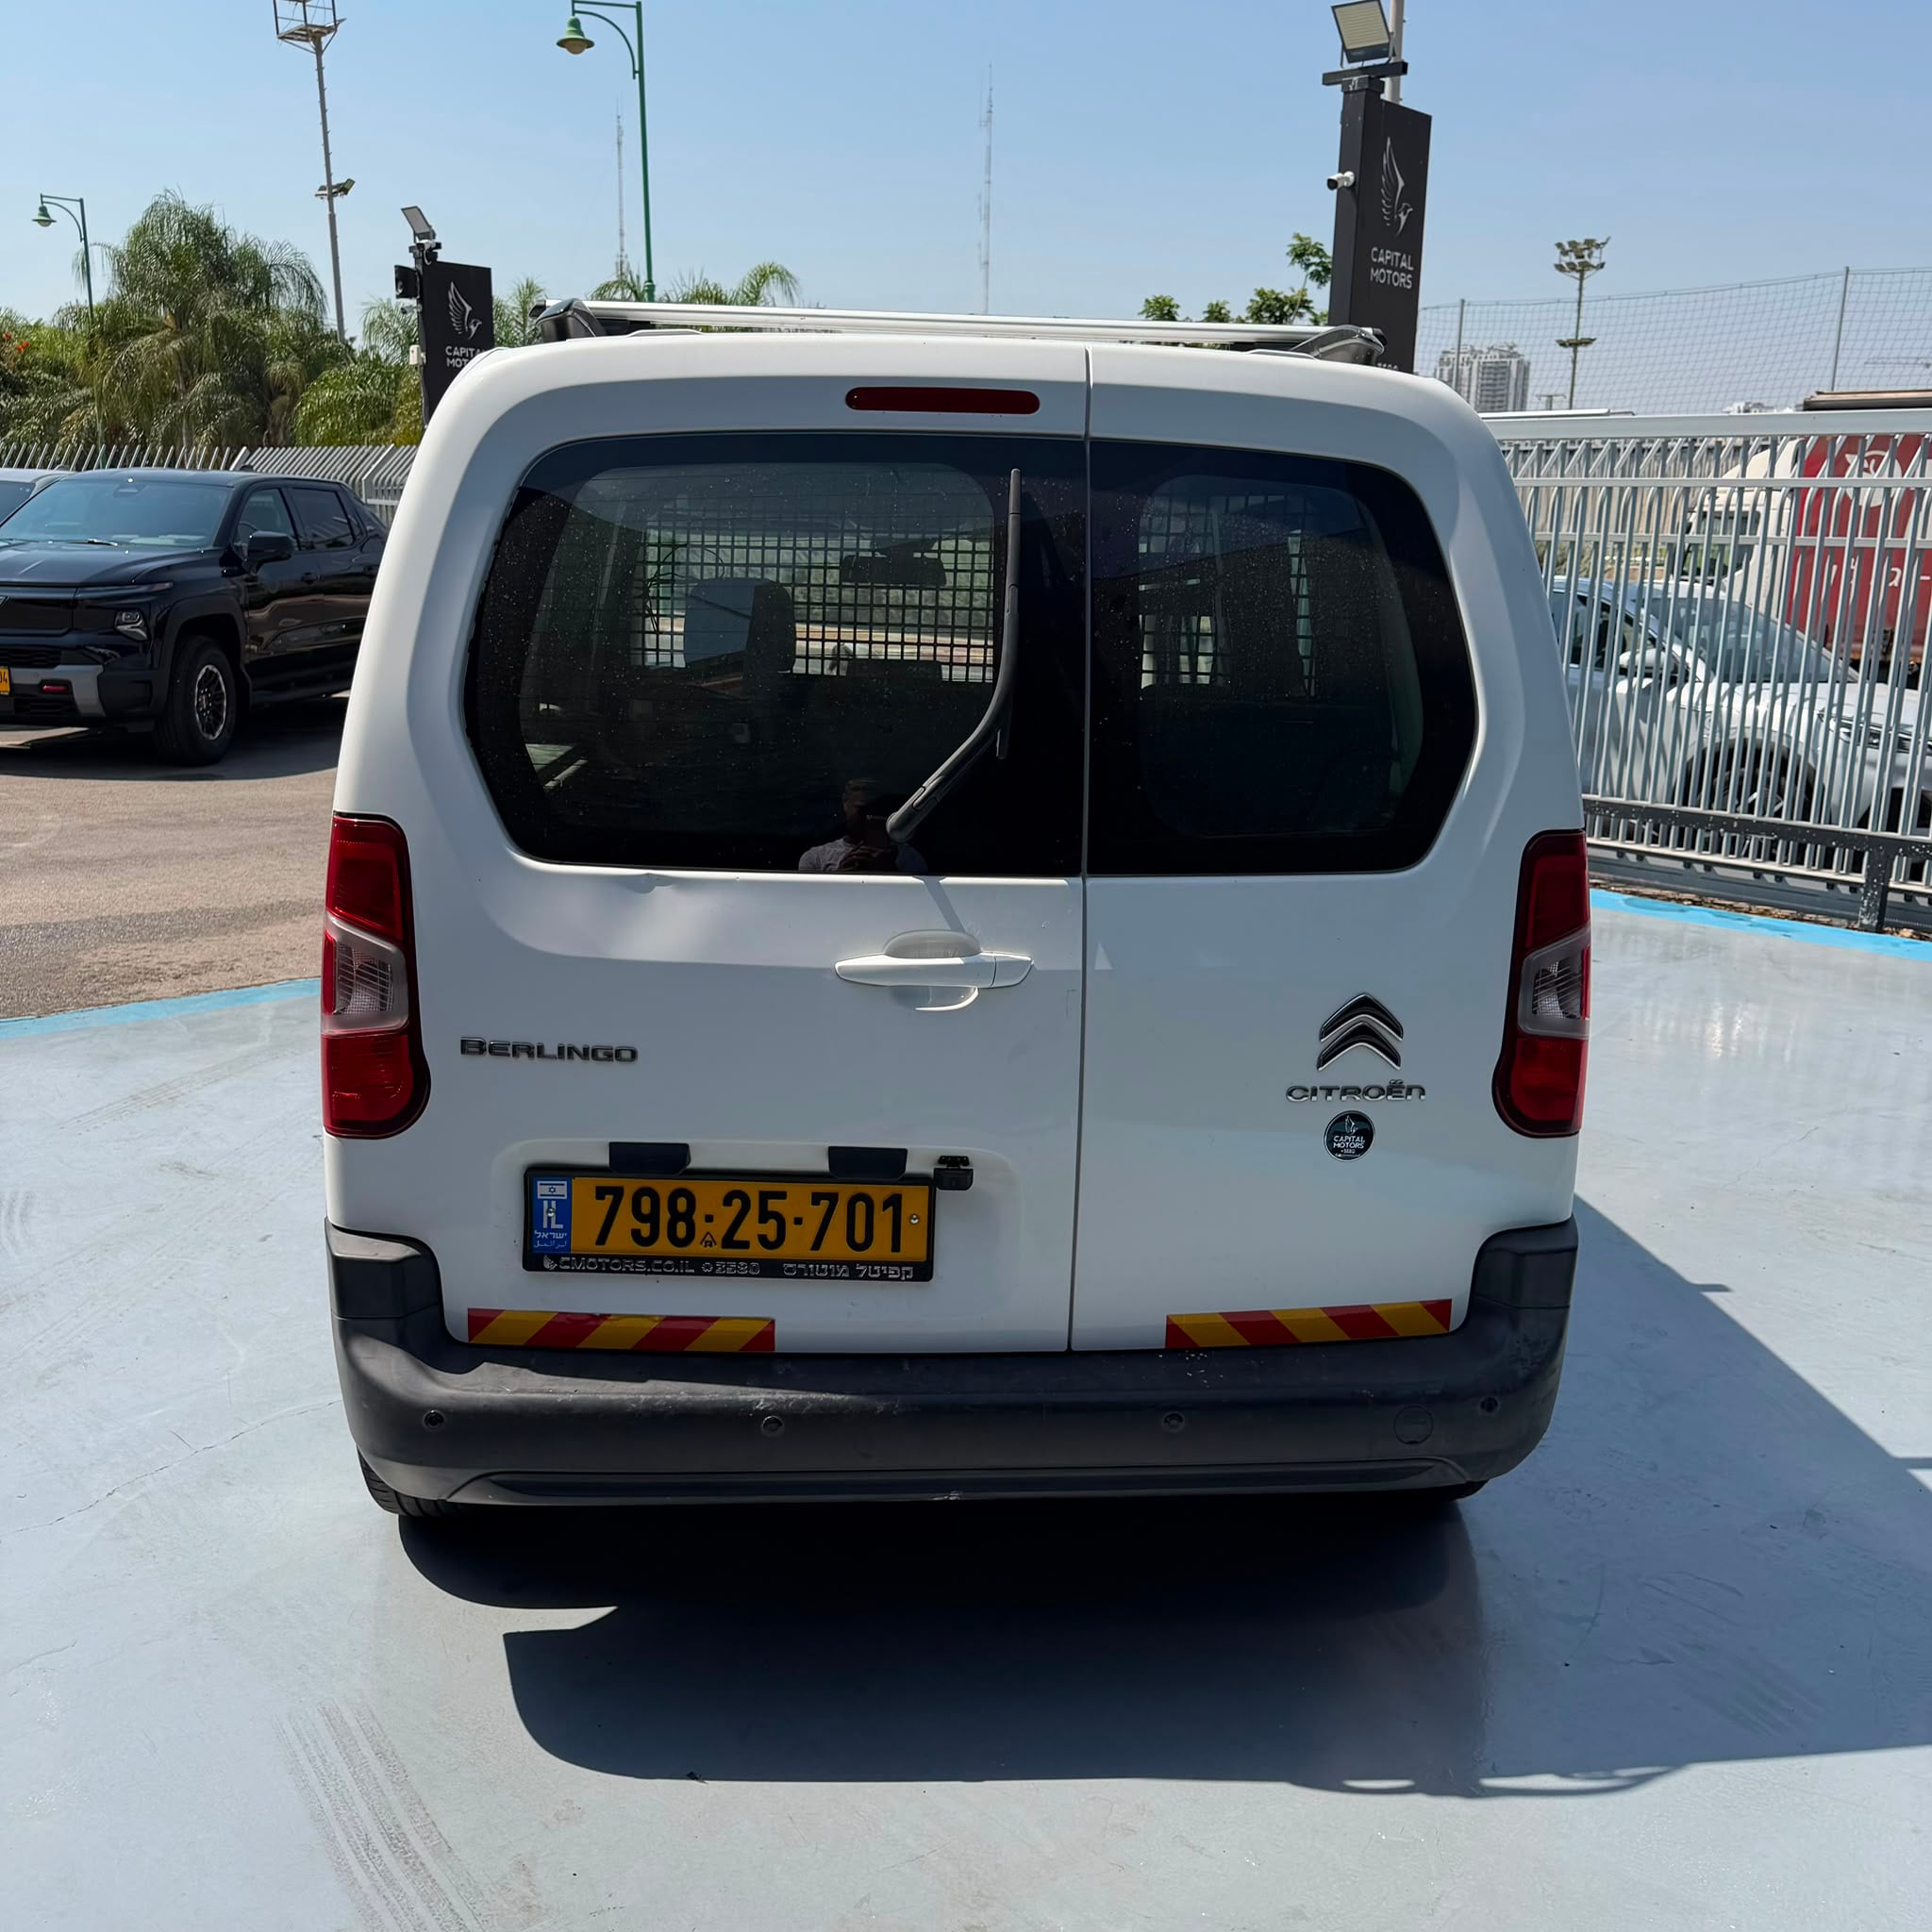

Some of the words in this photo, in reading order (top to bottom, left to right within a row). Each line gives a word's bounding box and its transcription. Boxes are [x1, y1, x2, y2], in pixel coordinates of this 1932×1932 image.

[1371, 246, 1414, 271] CAPITAL
[1370, 267, 1412, 290] MOTORS
[445, 345, 486, 358] CAPIT
[460, 1036, 638, 1062] BERLINGO
[1333, 1135, 1366, 1143] CAPITAL
[542, 1200, 564, 1229] IL
[534, 1229, 567, 1240] ישראל
[558, 1257, 695, 1274] CMOTORS.CO.IL
[782, 1263, 850, 1277] מוטורס
[856, 1263, 914, 1281] קפיטל
